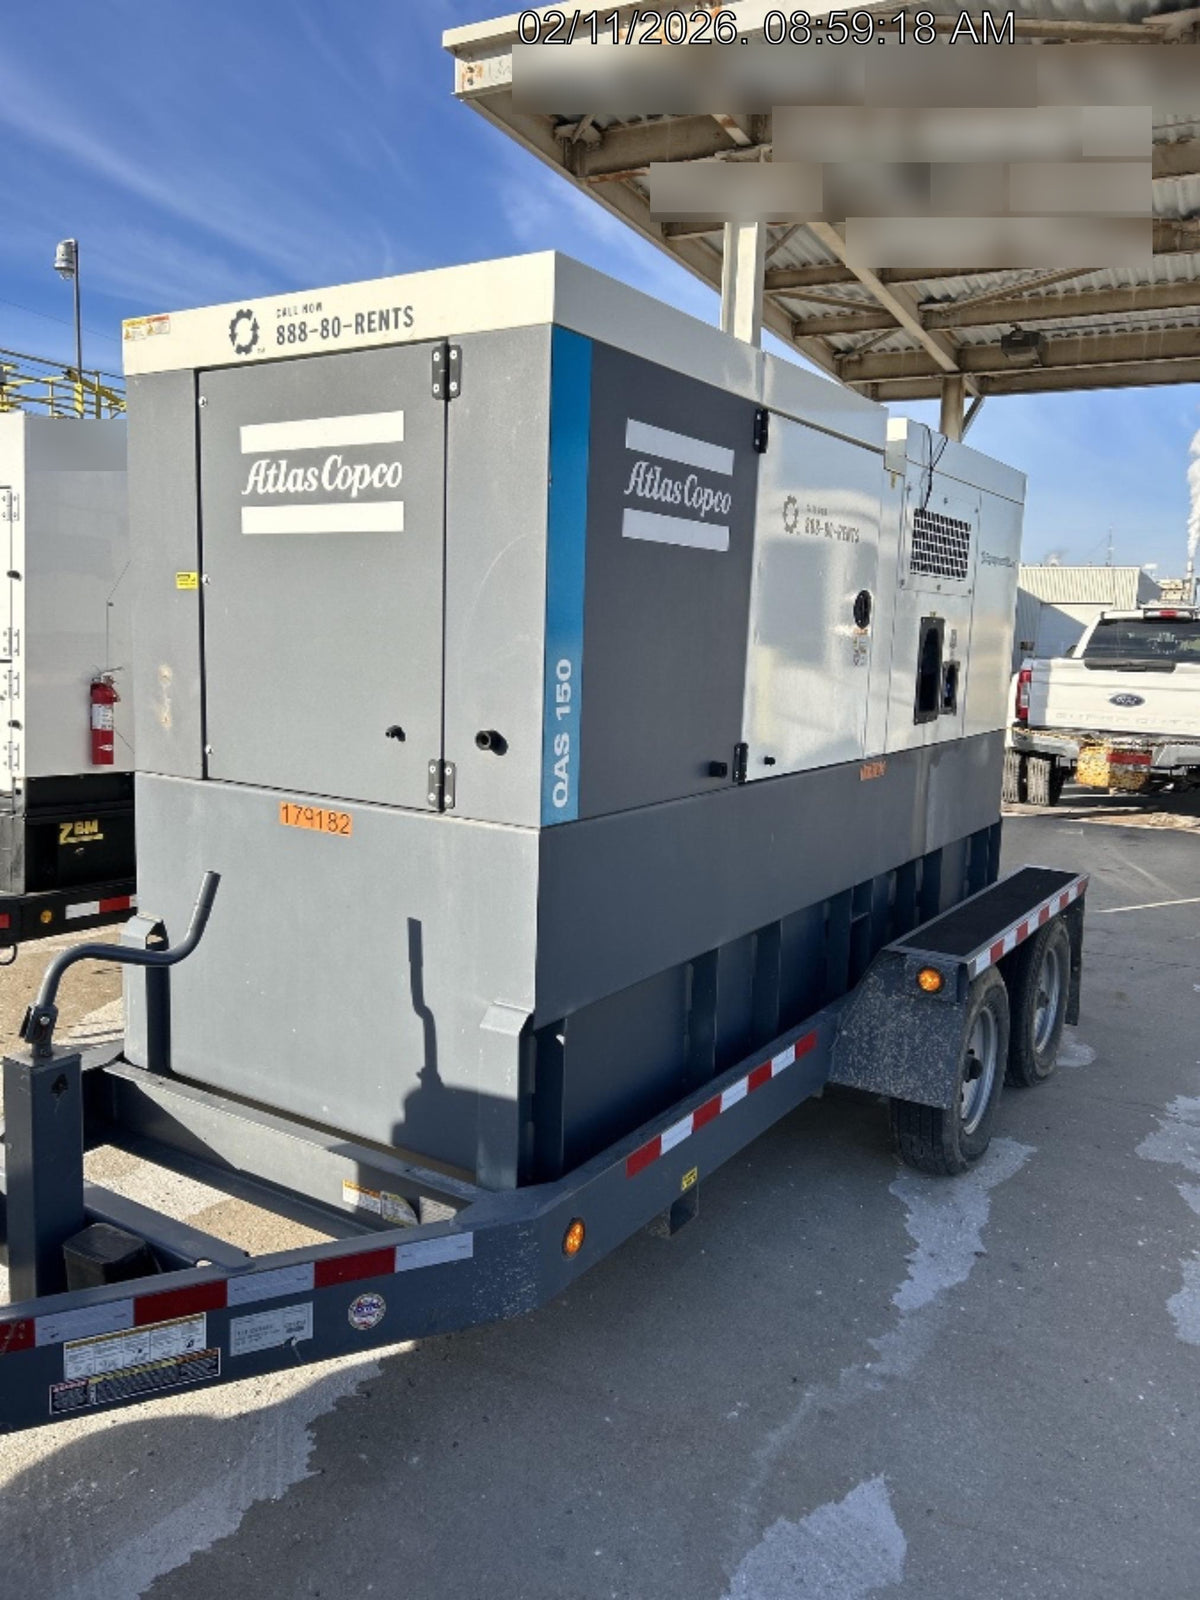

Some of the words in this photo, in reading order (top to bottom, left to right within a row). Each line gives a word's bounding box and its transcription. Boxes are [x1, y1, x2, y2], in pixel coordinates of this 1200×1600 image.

[276, 305, 415, 346] 888-80-RENTS
[241, 459, 319, 496] Atlas
[320, 454, 403, 498] Copco
[623, 460, 682, 504] Atlas
[683, 473, 732, 518] Copco
[556, 658, 572, 721] 150
[552, 731, 570, 809] QAS
[281, 803, 352, 835] 179182
